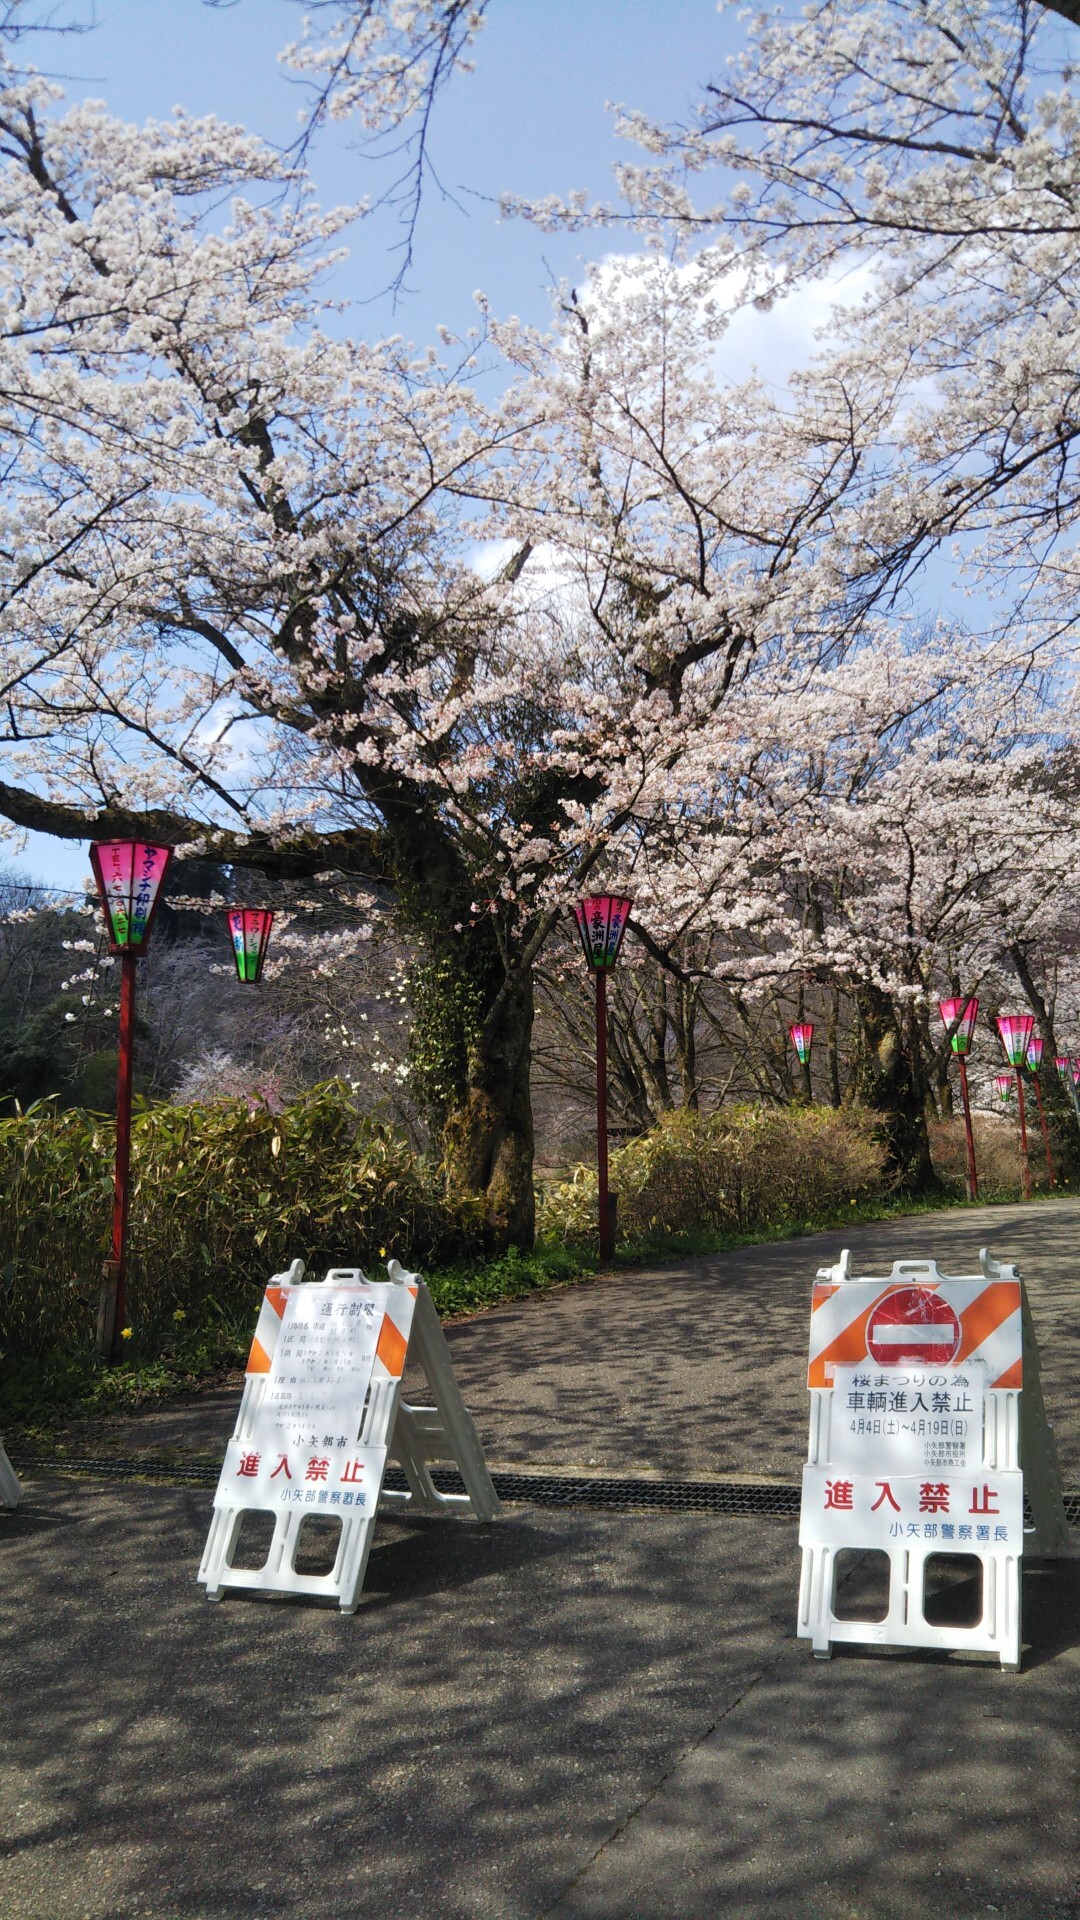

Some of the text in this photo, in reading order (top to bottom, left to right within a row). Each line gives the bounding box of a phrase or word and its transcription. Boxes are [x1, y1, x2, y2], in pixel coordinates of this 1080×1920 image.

[851, 1374, 970, 1388] 桜まつりの為
[292, 1434, 348, 1448] 小矢部市
[924, 1441, 966, 1450] 小矢部警察署
[236, 1451, 365, 1483] 進入禁止
[280, 1488, 366, 1506] 小矢部警察署長
[824, 1479, 1000, 1514] 進入禁止
[889, 1522, 1009, 1542] 小矢部警察署長
